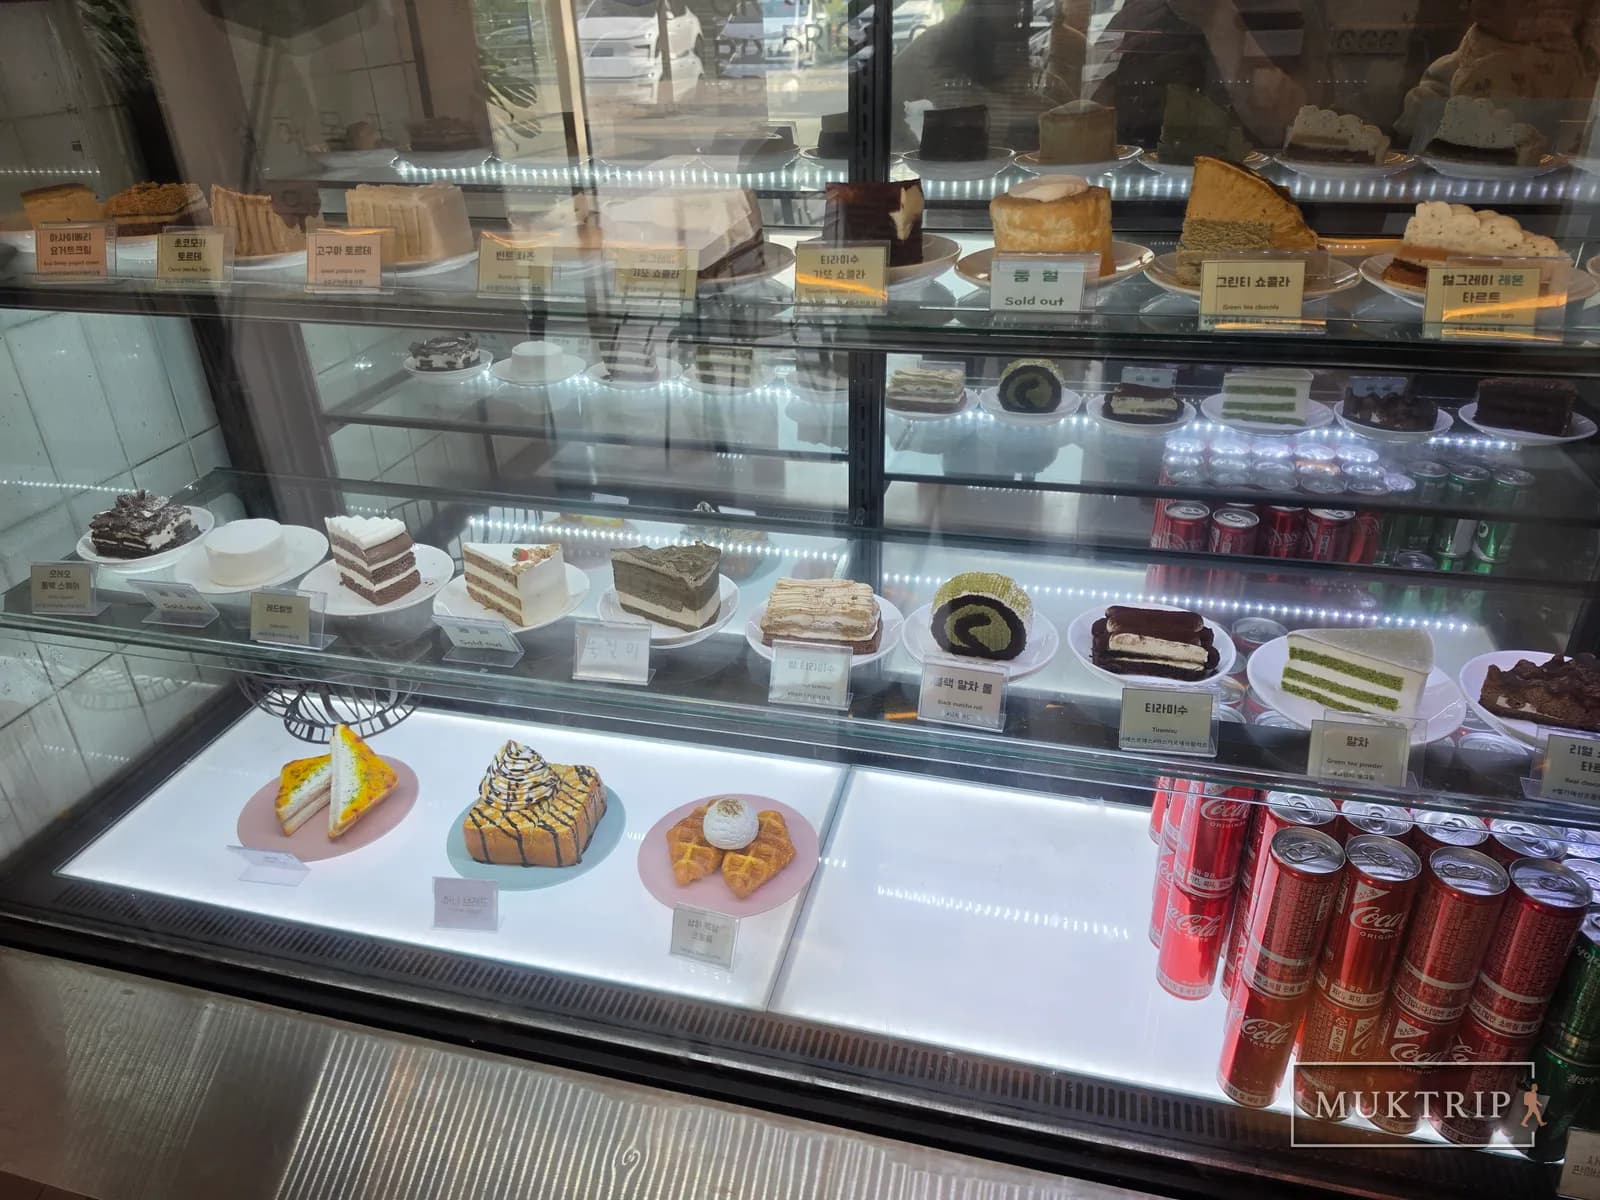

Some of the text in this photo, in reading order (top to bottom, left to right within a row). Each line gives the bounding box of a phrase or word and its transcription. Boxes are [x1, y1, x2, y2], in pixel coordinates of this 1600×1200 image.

[316, 246, 372, 256] 고구마 토르테
[820, 254, 859, 265] 티라미수
[1216, 276, 1291, 288] 그린티 쇼콜라
[1442, 274, 1524, 287] 얼그레이 레몬
[1005, 295, 1064, 307] Sold out
[1462, 291, 1502, 304] 타르트
[957, 679, 980, 692] 말차
[1144, 702, 1189, 715] 티라미수
[1346, 735, 1370, 748] 말차
[1569, 744, 1593, 757] 리얼
